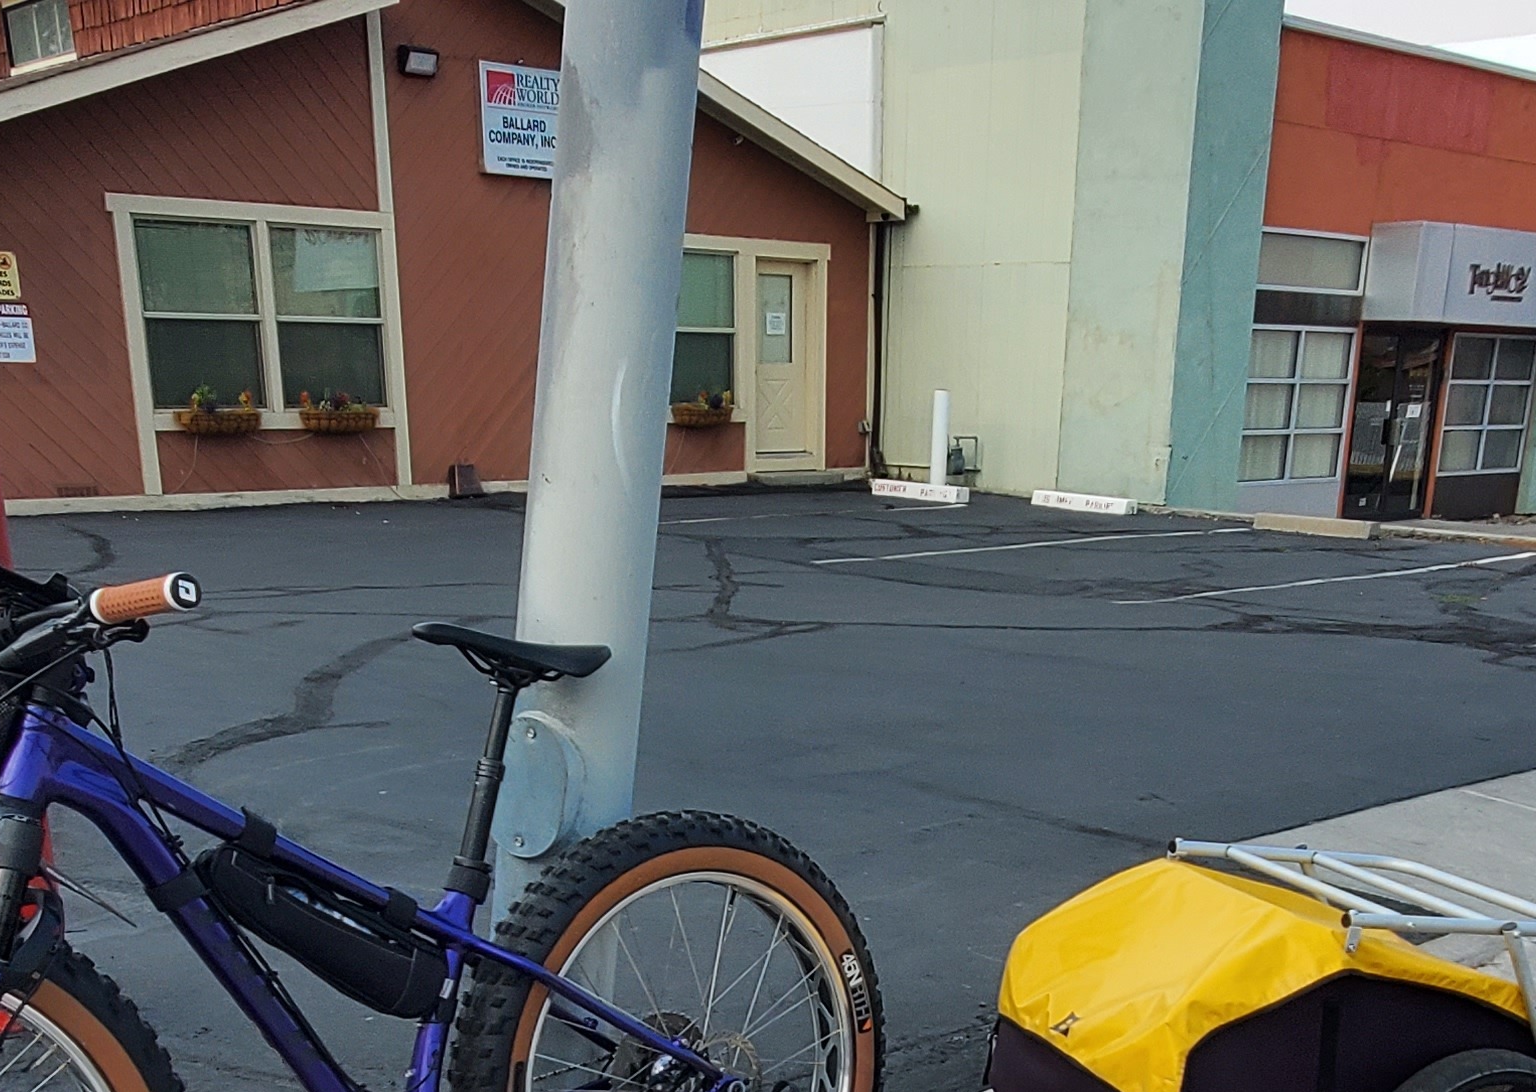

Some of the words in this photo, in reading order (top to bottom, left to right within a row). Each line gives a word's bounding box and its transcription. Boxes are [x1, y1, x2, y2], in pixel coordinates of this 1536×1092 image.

[516, 73, 561, 92] REALTY
[517, 89, 559, 105] WORLD
[502, 116, 547, 133] BALLARD
[488, 130, 539, 149] COMPANY,
